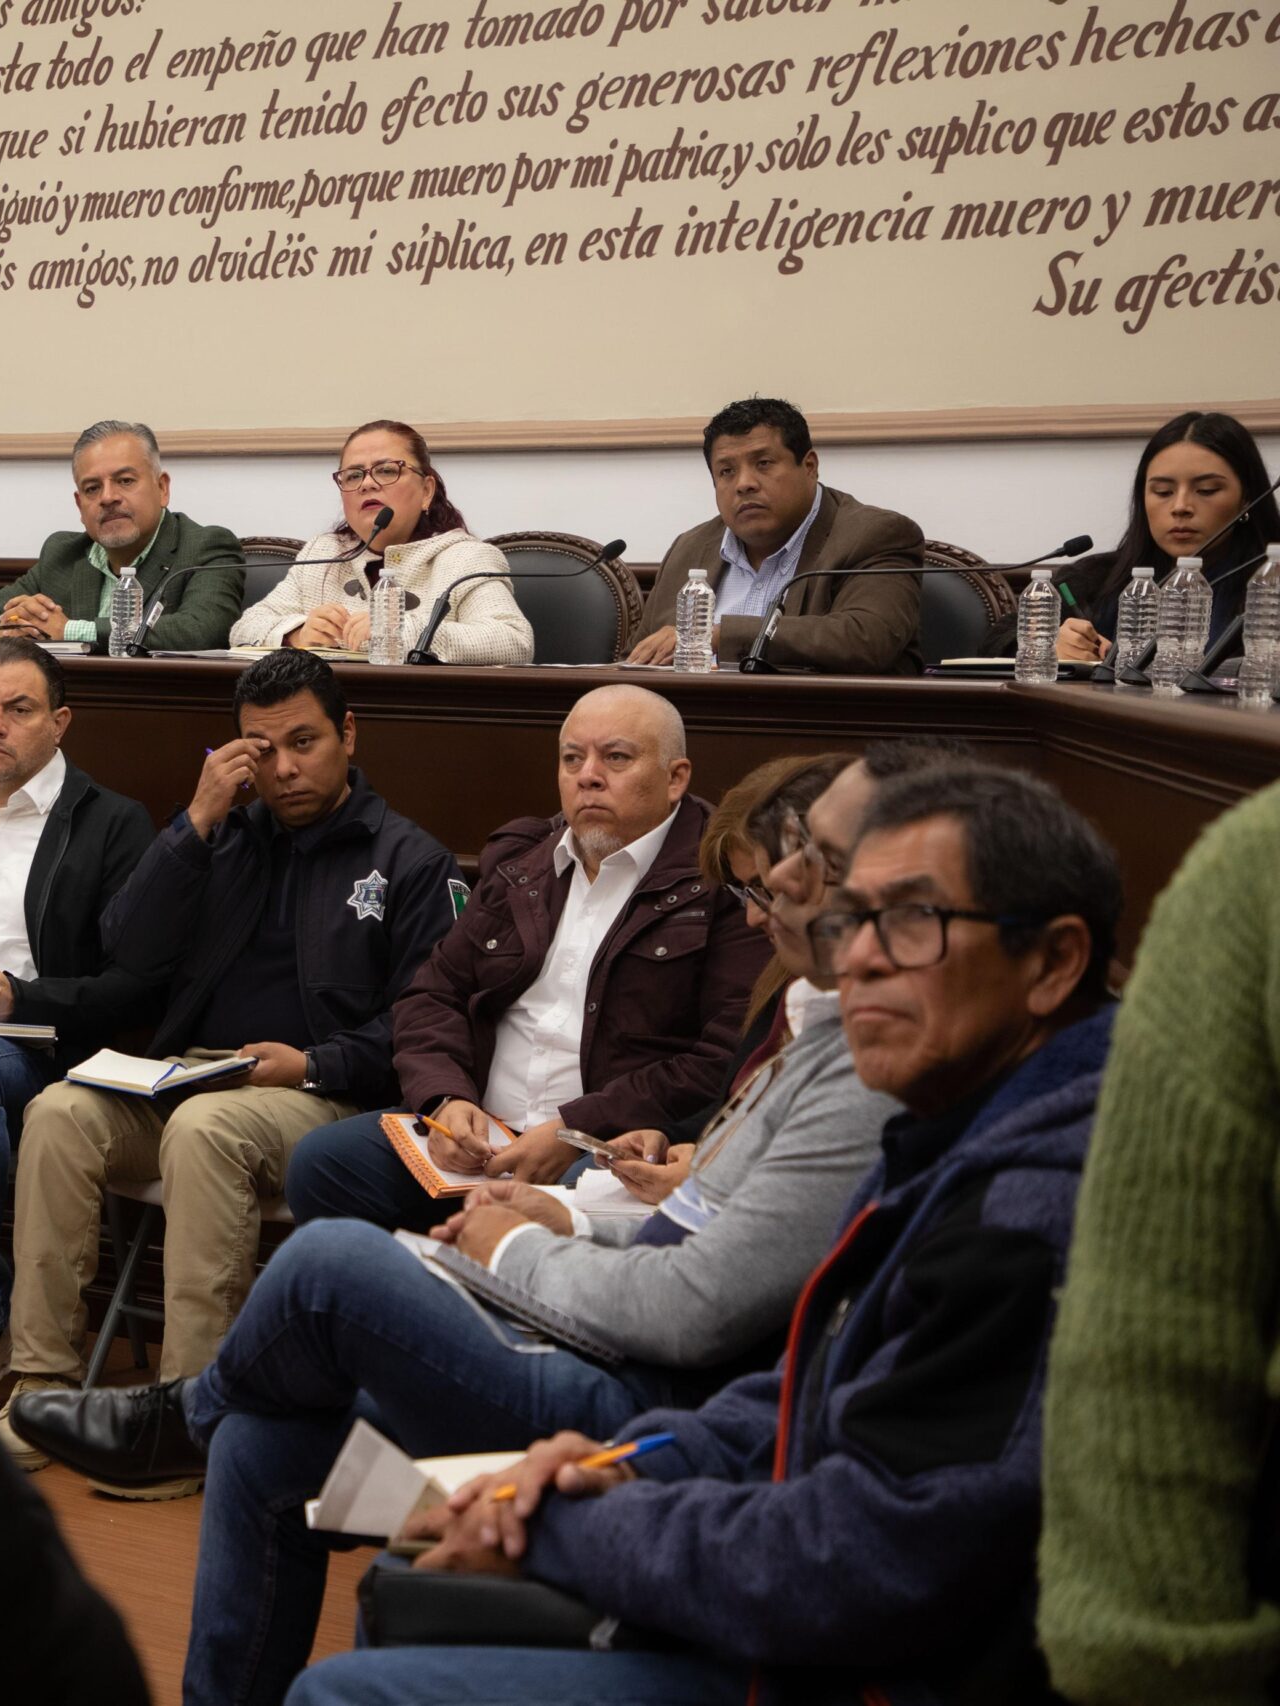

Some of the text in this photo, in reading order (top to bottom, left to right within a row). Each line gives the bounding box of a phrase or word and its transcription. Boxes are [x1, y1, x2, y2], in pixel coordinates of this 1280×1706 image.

[45, 35, 114, 90] todo
[124, 28, 164, 83] el
[166, 29, 297, 92] empeño
[305, 28, 368, 83] que
[371, 1, 450, 60] han
[464, 0, 605, 50] tomado
[607, 0, 689, 48] por
[58, 109, 92, 157] si
[93, 99, 247, 154] hubieran
[259, 80, 368, 141] tenido
[380, 69, 489, 146] efecto
[497, 81, 566, 121] sus
[565, 58, 796, 135] generosas
[805, 23, 1067, 107] reflexiones
[1069, 0, 1262, 67] hechas
[55, 193, 80, 236] y
[79, 188, 166, 223] muero
[407, 162, 507, 200] muero
[502, 152, 571, 208] por
[569, 137, 619, 189] mi
[754, 113, 832, 174] sólo
[835, 110, 893, 167] les
[896, 99, 1038, 175] suplico
[1043, 108, 1117, 167] que
[1122, 81, 1240, 145] estos
[28, 242, 137, 309] amigos,
[140, 255, 180, 287] no
[188, 230, 319, 284] olvidéis
[326, 229, 378, 277] mi
[385, 218, 515, 286] súplica,
[524, 231, 569, 266] en
[578, 206, 664, 263] esta
[674, 190, 935, 276] inteligencia
[940, 194, 1092, 241] muero
[1093, 190, 1132, 248] y
[1142, 178, 1280, 228] muer
[1032, 248, 1280, 335] Su afectís
